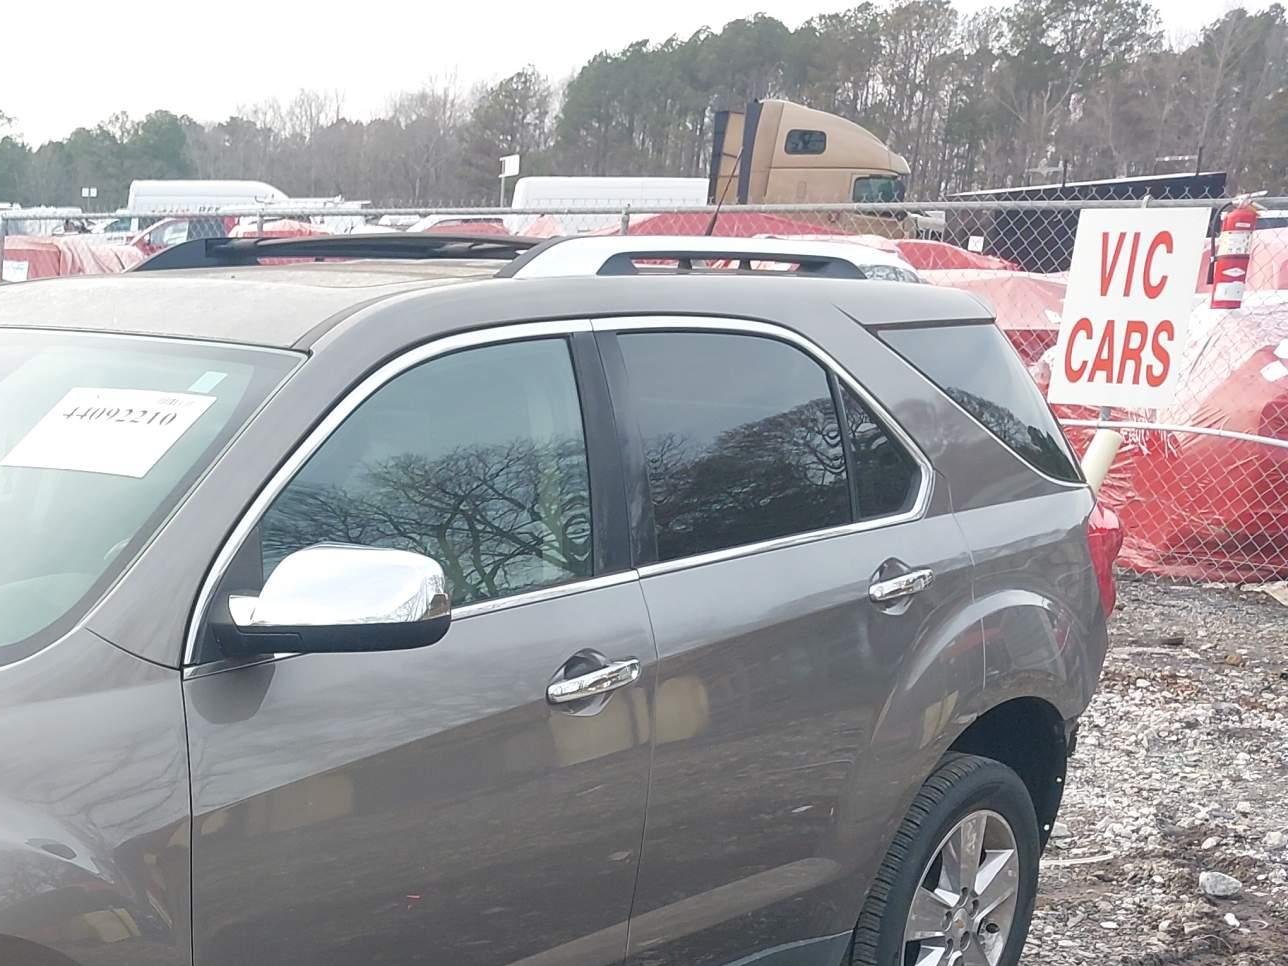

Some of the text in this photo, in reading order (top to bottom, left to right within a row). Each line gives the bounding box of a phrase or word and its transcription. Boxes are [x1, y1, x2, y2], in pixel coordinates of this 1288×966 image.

[1100, 231, 1173, 299] VIC
[1065, 317, 1174, 387] CARS
[63, 406, 177, 425] 44092210
